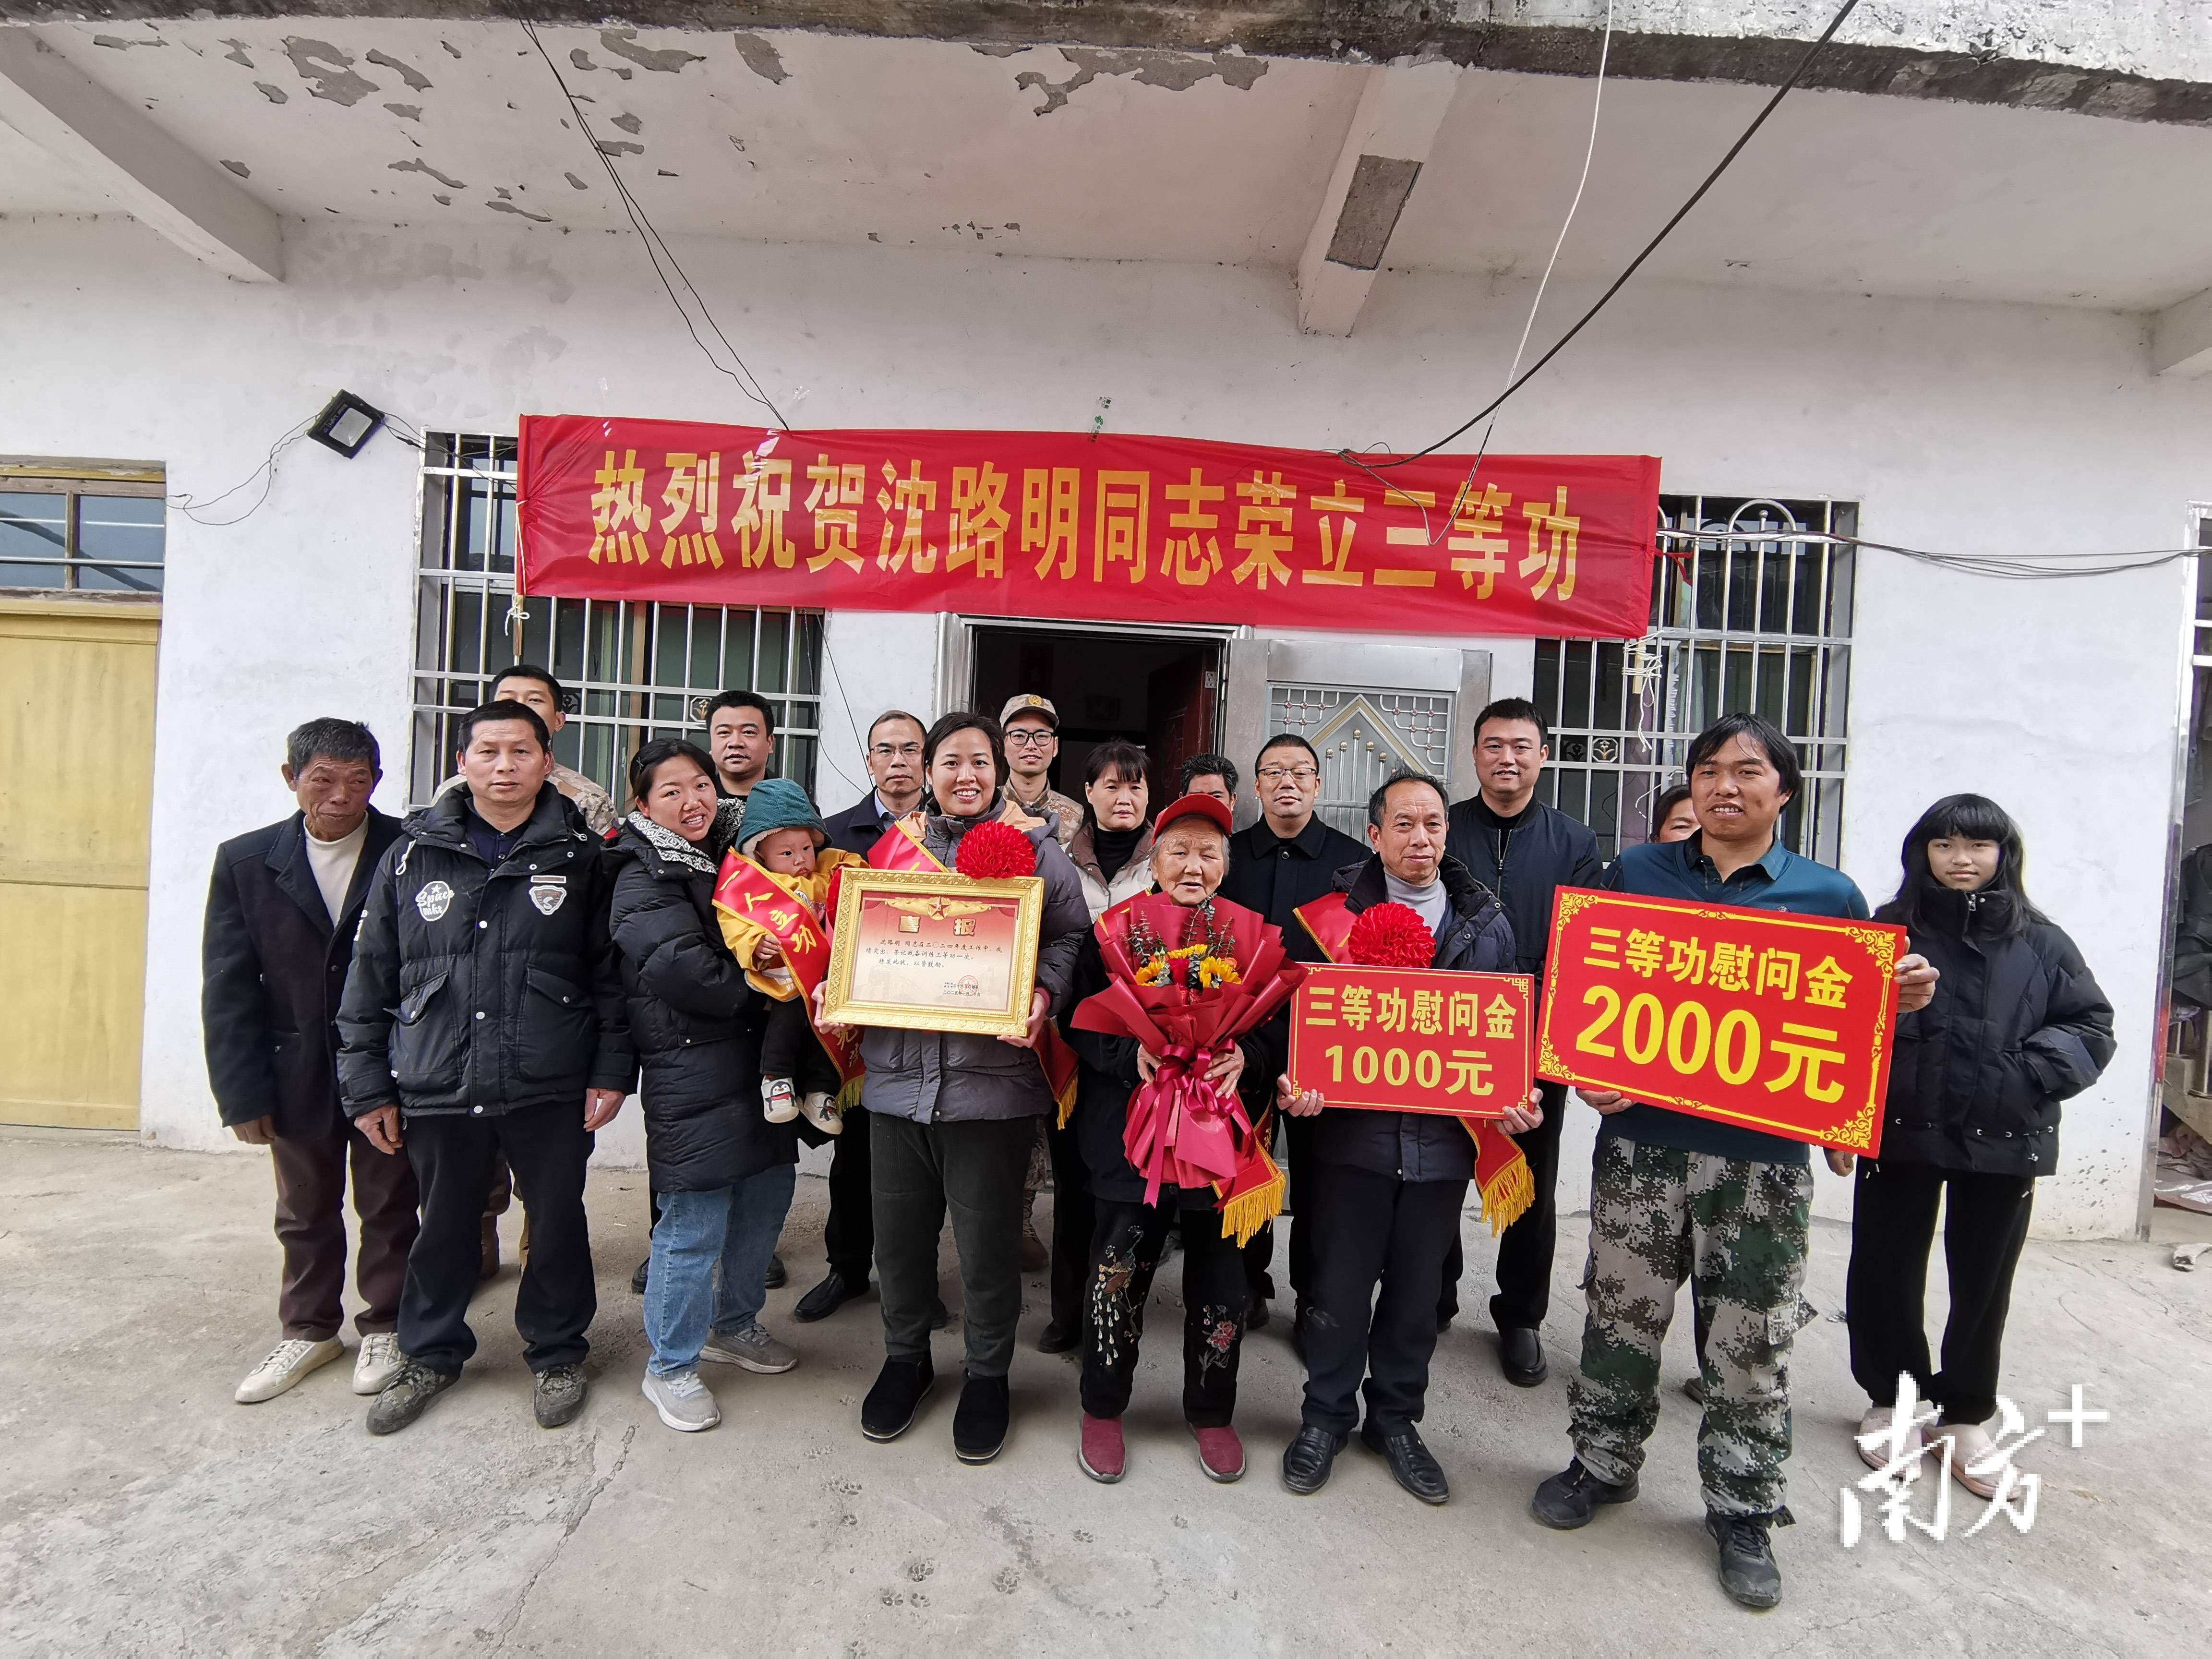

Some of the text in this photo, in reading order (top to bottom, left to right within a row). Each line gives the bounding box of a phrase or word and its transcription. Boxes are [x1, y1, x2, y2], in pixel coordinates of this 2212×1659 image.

[589, 449, 1580, 601] 热烈祝贺沈路明同志荣立三等功
[415, 890, 455, 907] Space
[1583, 926, 1853, 1010] 三等功慰问金
[1306, 984, 1517, 1039] 三等功慰问金
[1575, 985, 1846, 1104] 2000元
[1325, 1045, 1494, 1096] 1000元
